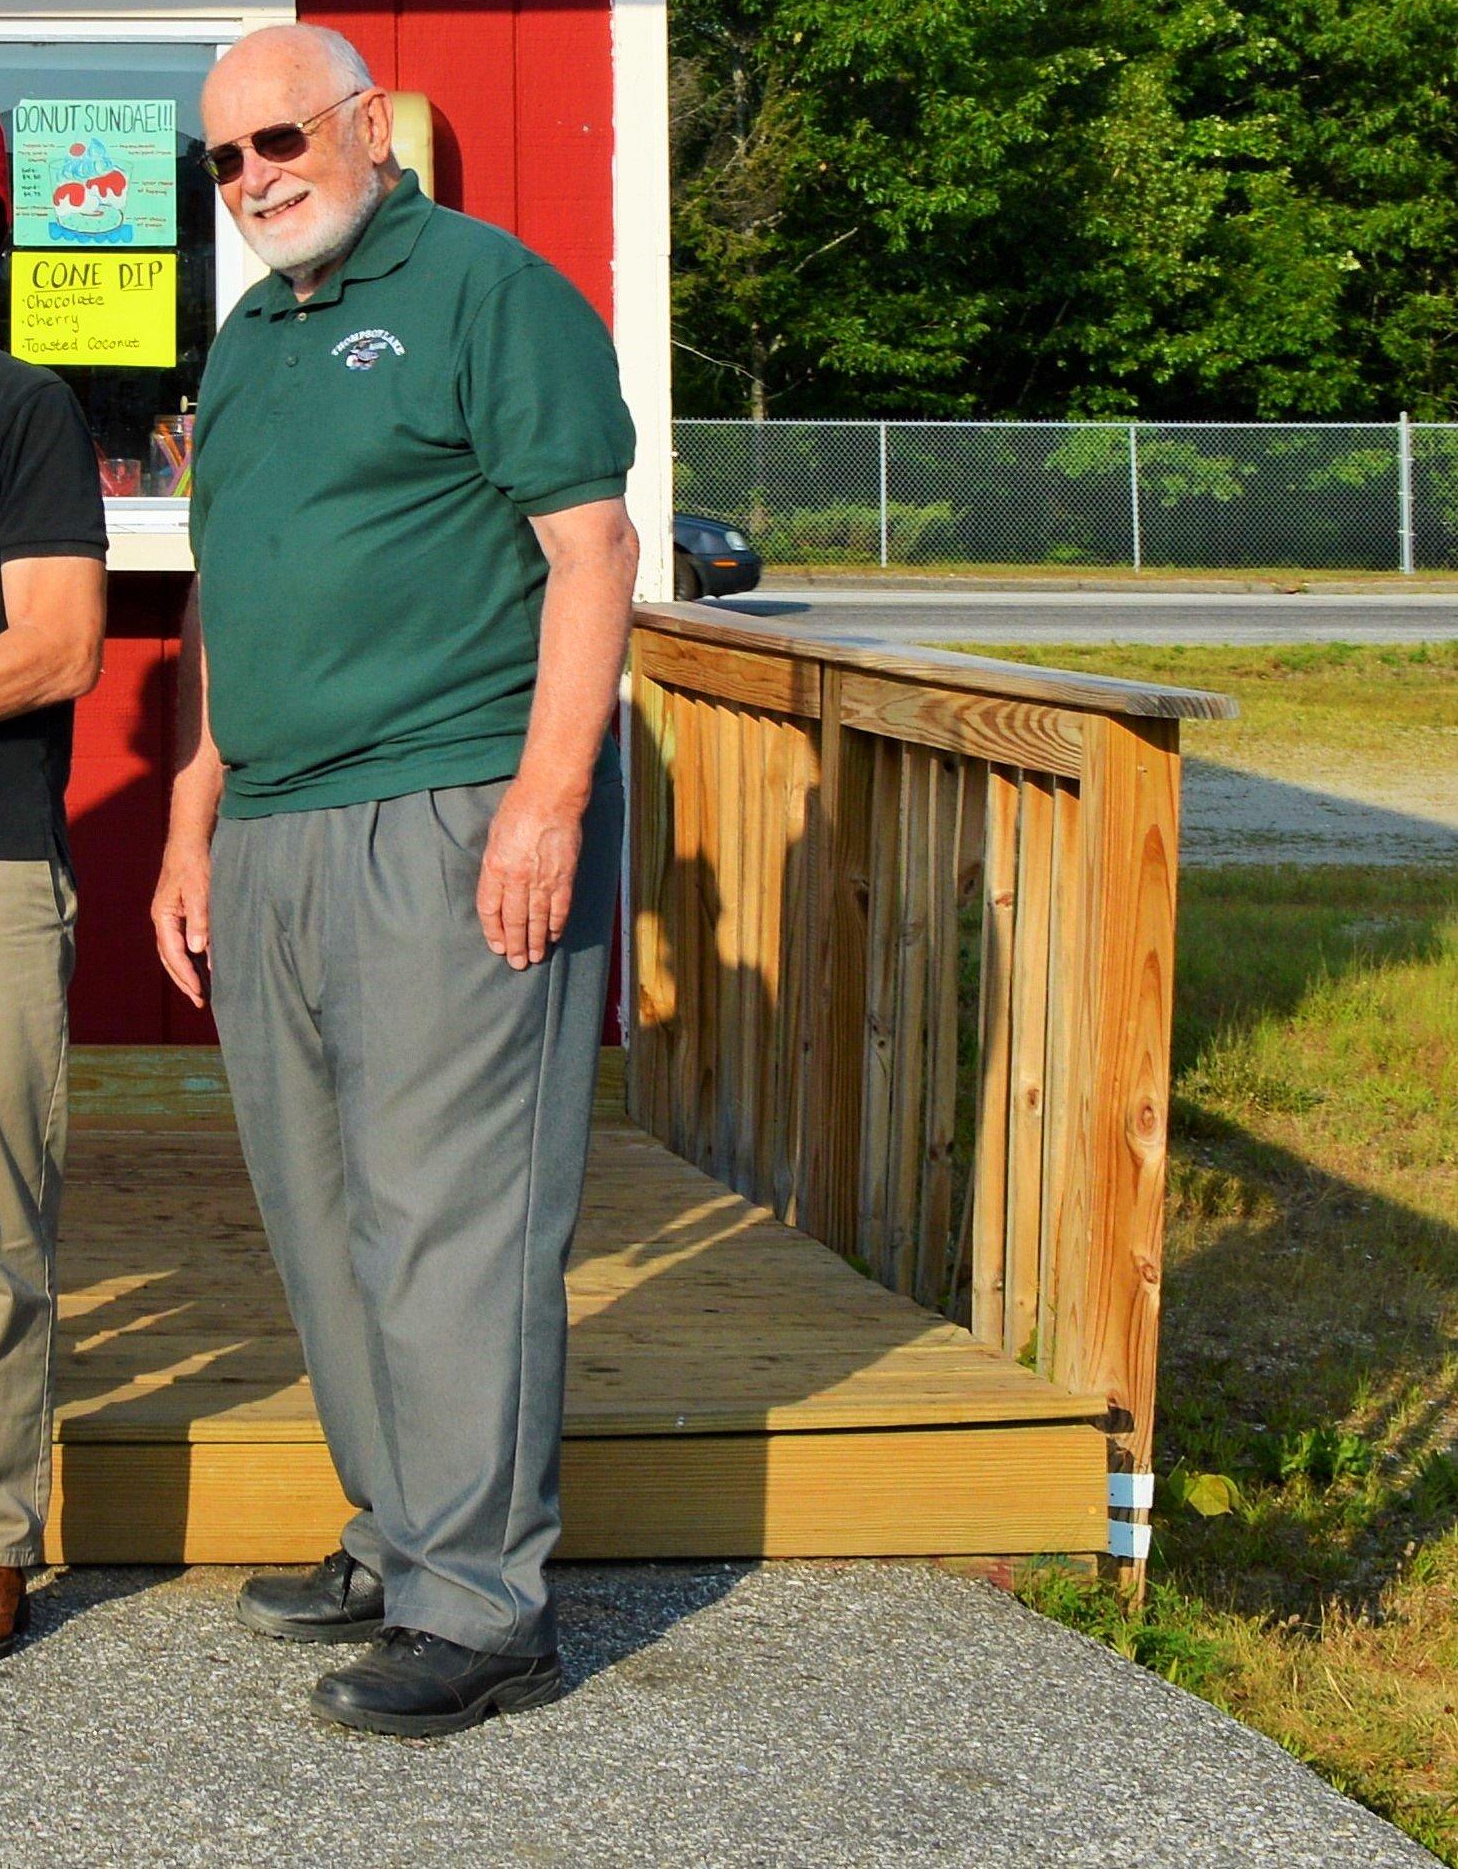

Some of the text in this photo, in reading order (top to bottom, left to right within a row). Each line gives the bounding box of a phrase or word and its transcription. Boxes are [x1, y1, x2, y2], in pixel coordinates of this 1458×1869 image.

[15, 103, 173, 134] DONUT SUNDAE!!!
[32, 260, 163, 289] CONE DIP
[26, 293, 104, 309] Chocolate
[26, 313, 79, 332] Cherry
[25, 335, 140, 351] Toasted Coconut
